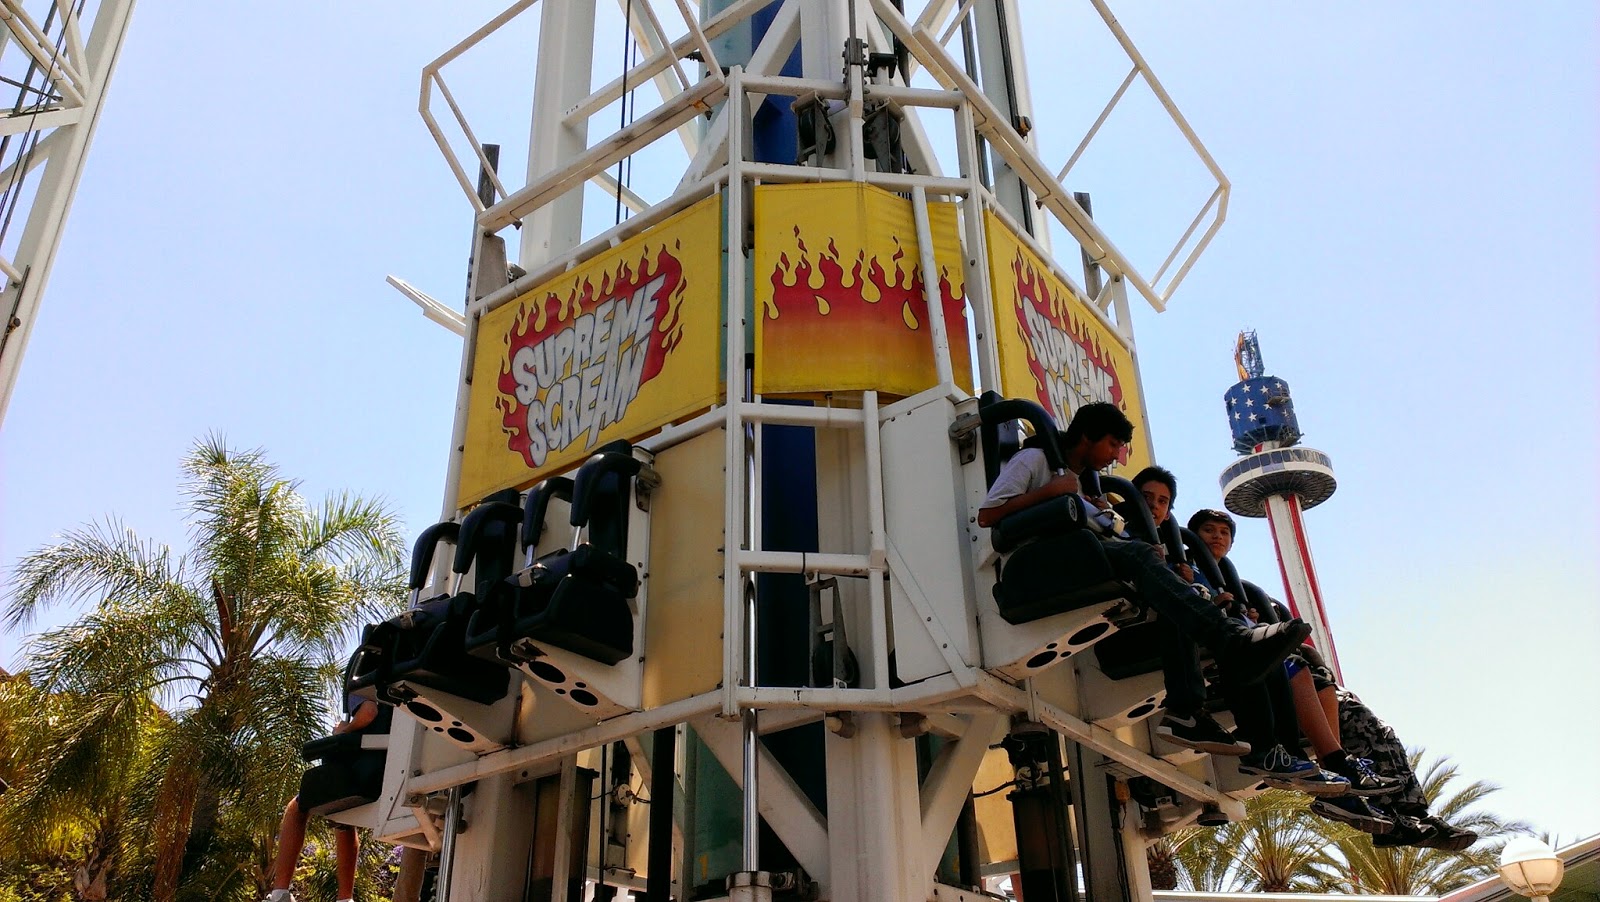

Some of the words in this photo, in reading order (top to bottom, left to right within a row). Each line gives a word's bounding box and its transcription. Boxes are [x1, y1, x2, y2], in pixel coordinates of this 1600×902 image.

[512, 273, 666, 406] SUPREME
[527, 339, 649, 467] SCREAM
[1023, 296, 1114, 405] SUPREME
